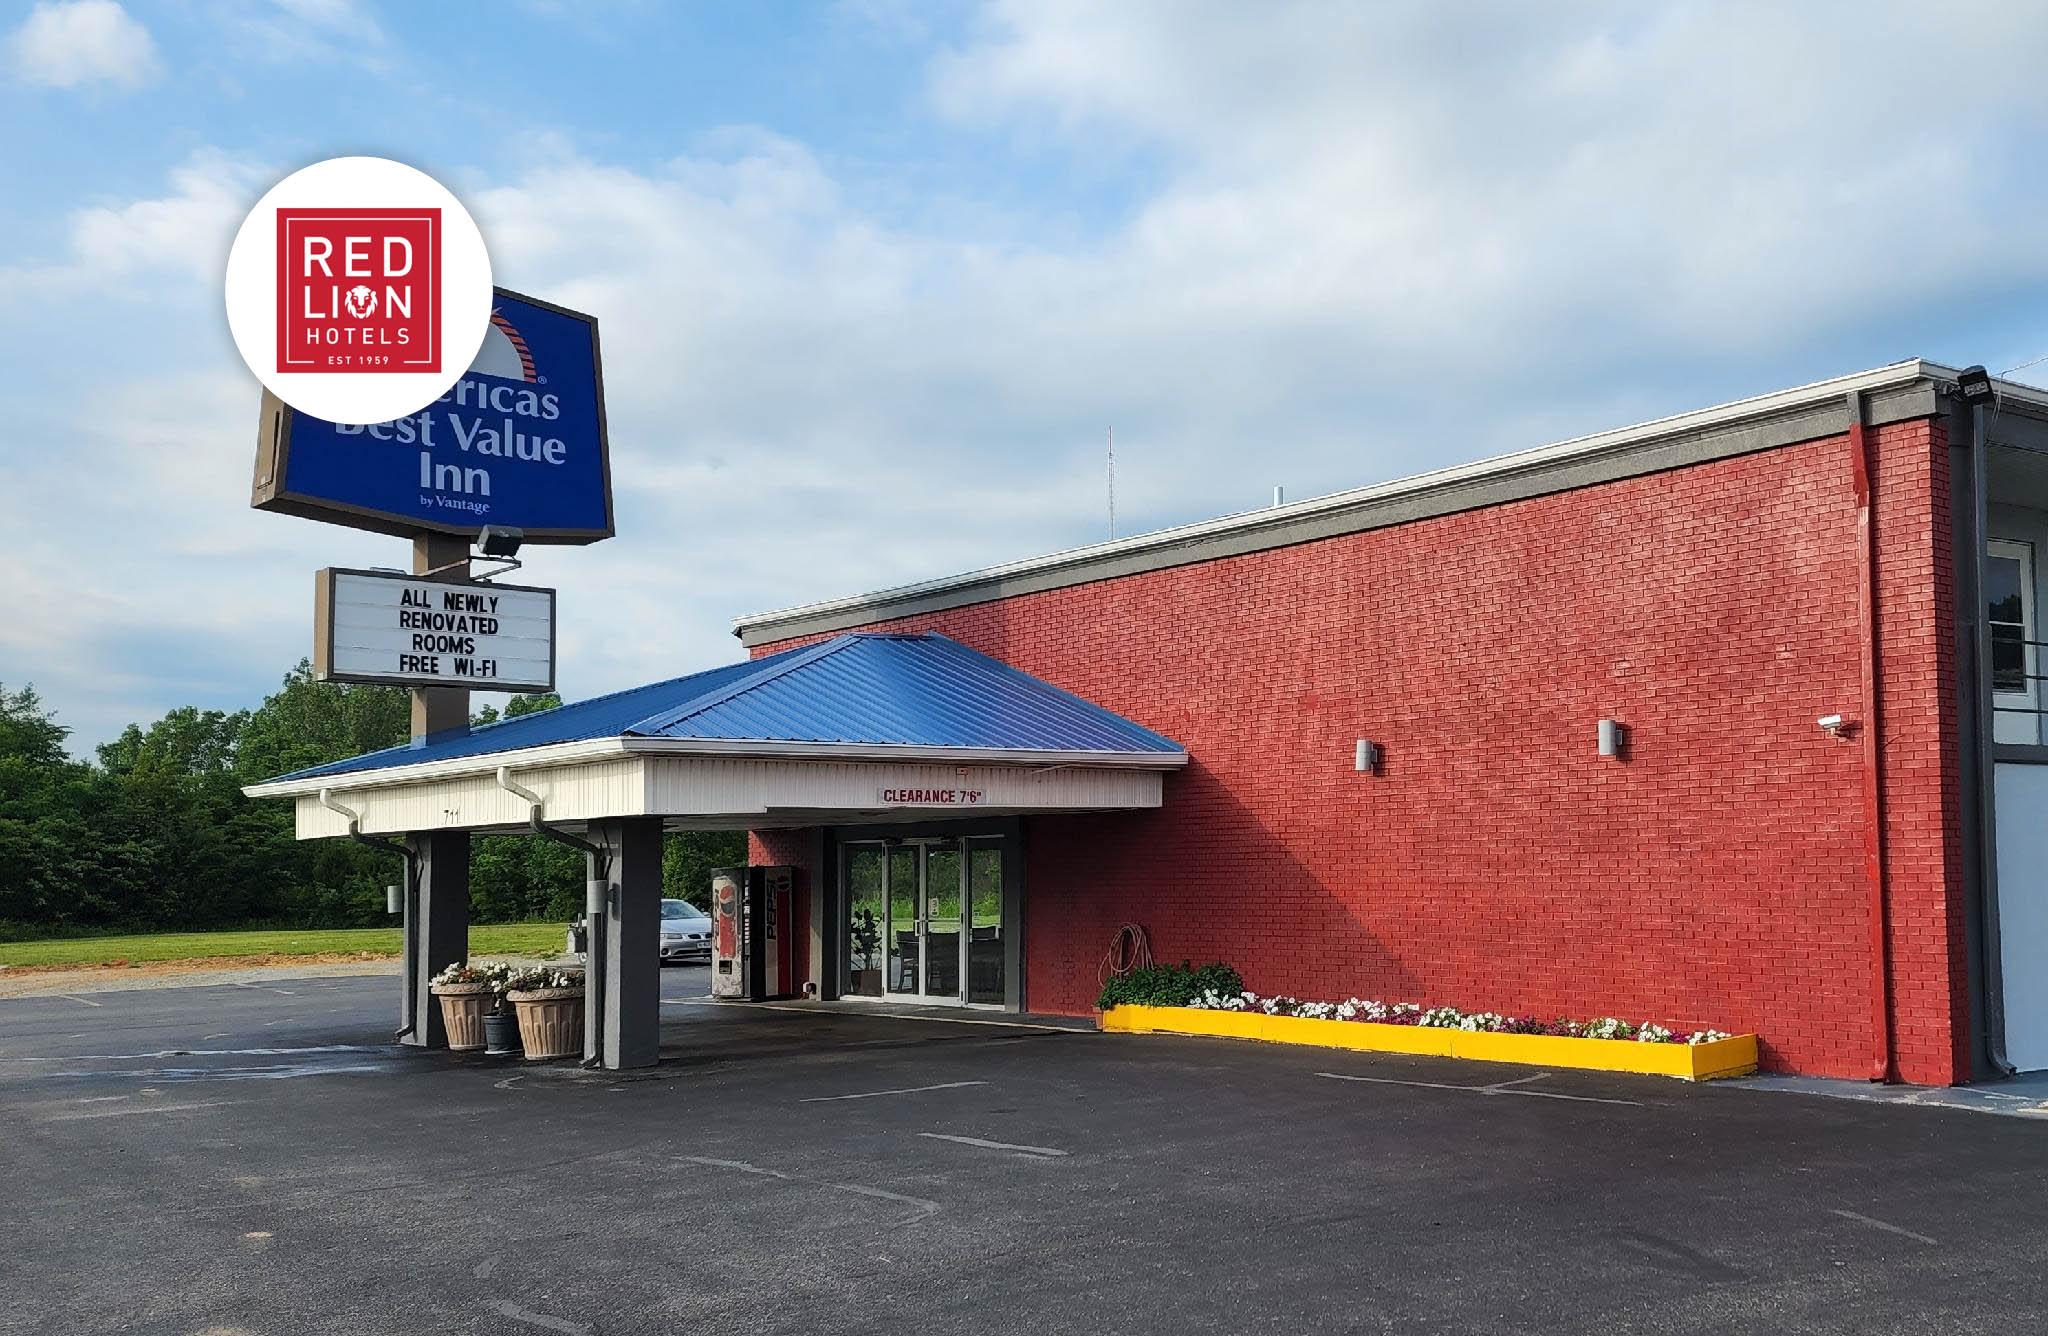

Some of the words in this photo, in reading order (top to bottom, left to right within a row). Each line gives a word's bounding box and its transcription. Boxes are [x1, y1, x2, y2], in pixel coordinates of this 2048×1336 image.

[448, 412, 567, 465] Value
[420, 451, 491, 497] Inn
[420, 494, 434, 508] by
[435, 494, 491, 515] Vantage
[400, 588, 432, 609] ALL
[443, 591, 499, 614] NEWLY
[399, 609, 499, 635] RENOVATED
[412, 633, 476, 655] ROOMS
[399, 653, 440, 674] FREE
[453, 657, 497, 677] WI-FI
[883, 789, 956, 803] CLEARANCE
